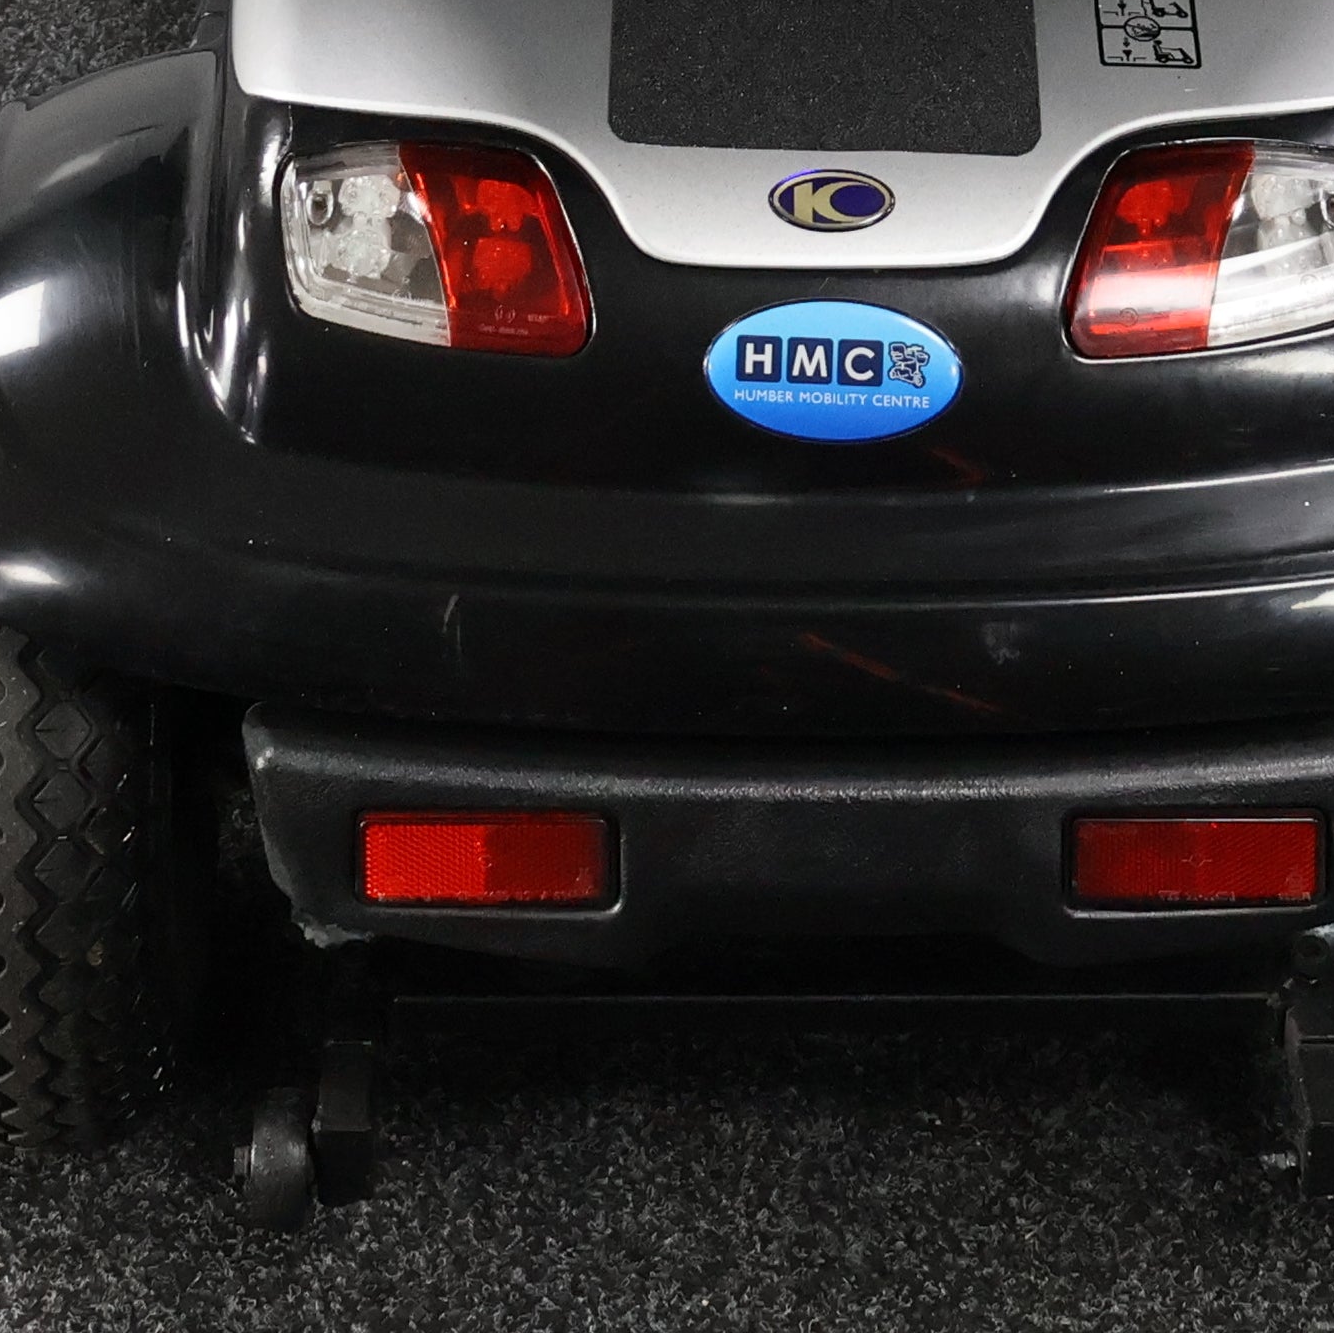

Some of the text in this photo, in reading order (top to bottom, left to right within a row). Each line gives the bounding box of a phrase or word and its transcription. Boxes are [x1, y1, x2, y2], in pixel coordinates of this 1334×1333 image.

[744, 342, 875, 381] HMC
[734, 389, 930, 409] HUMBER MOBILITY CENTRE
